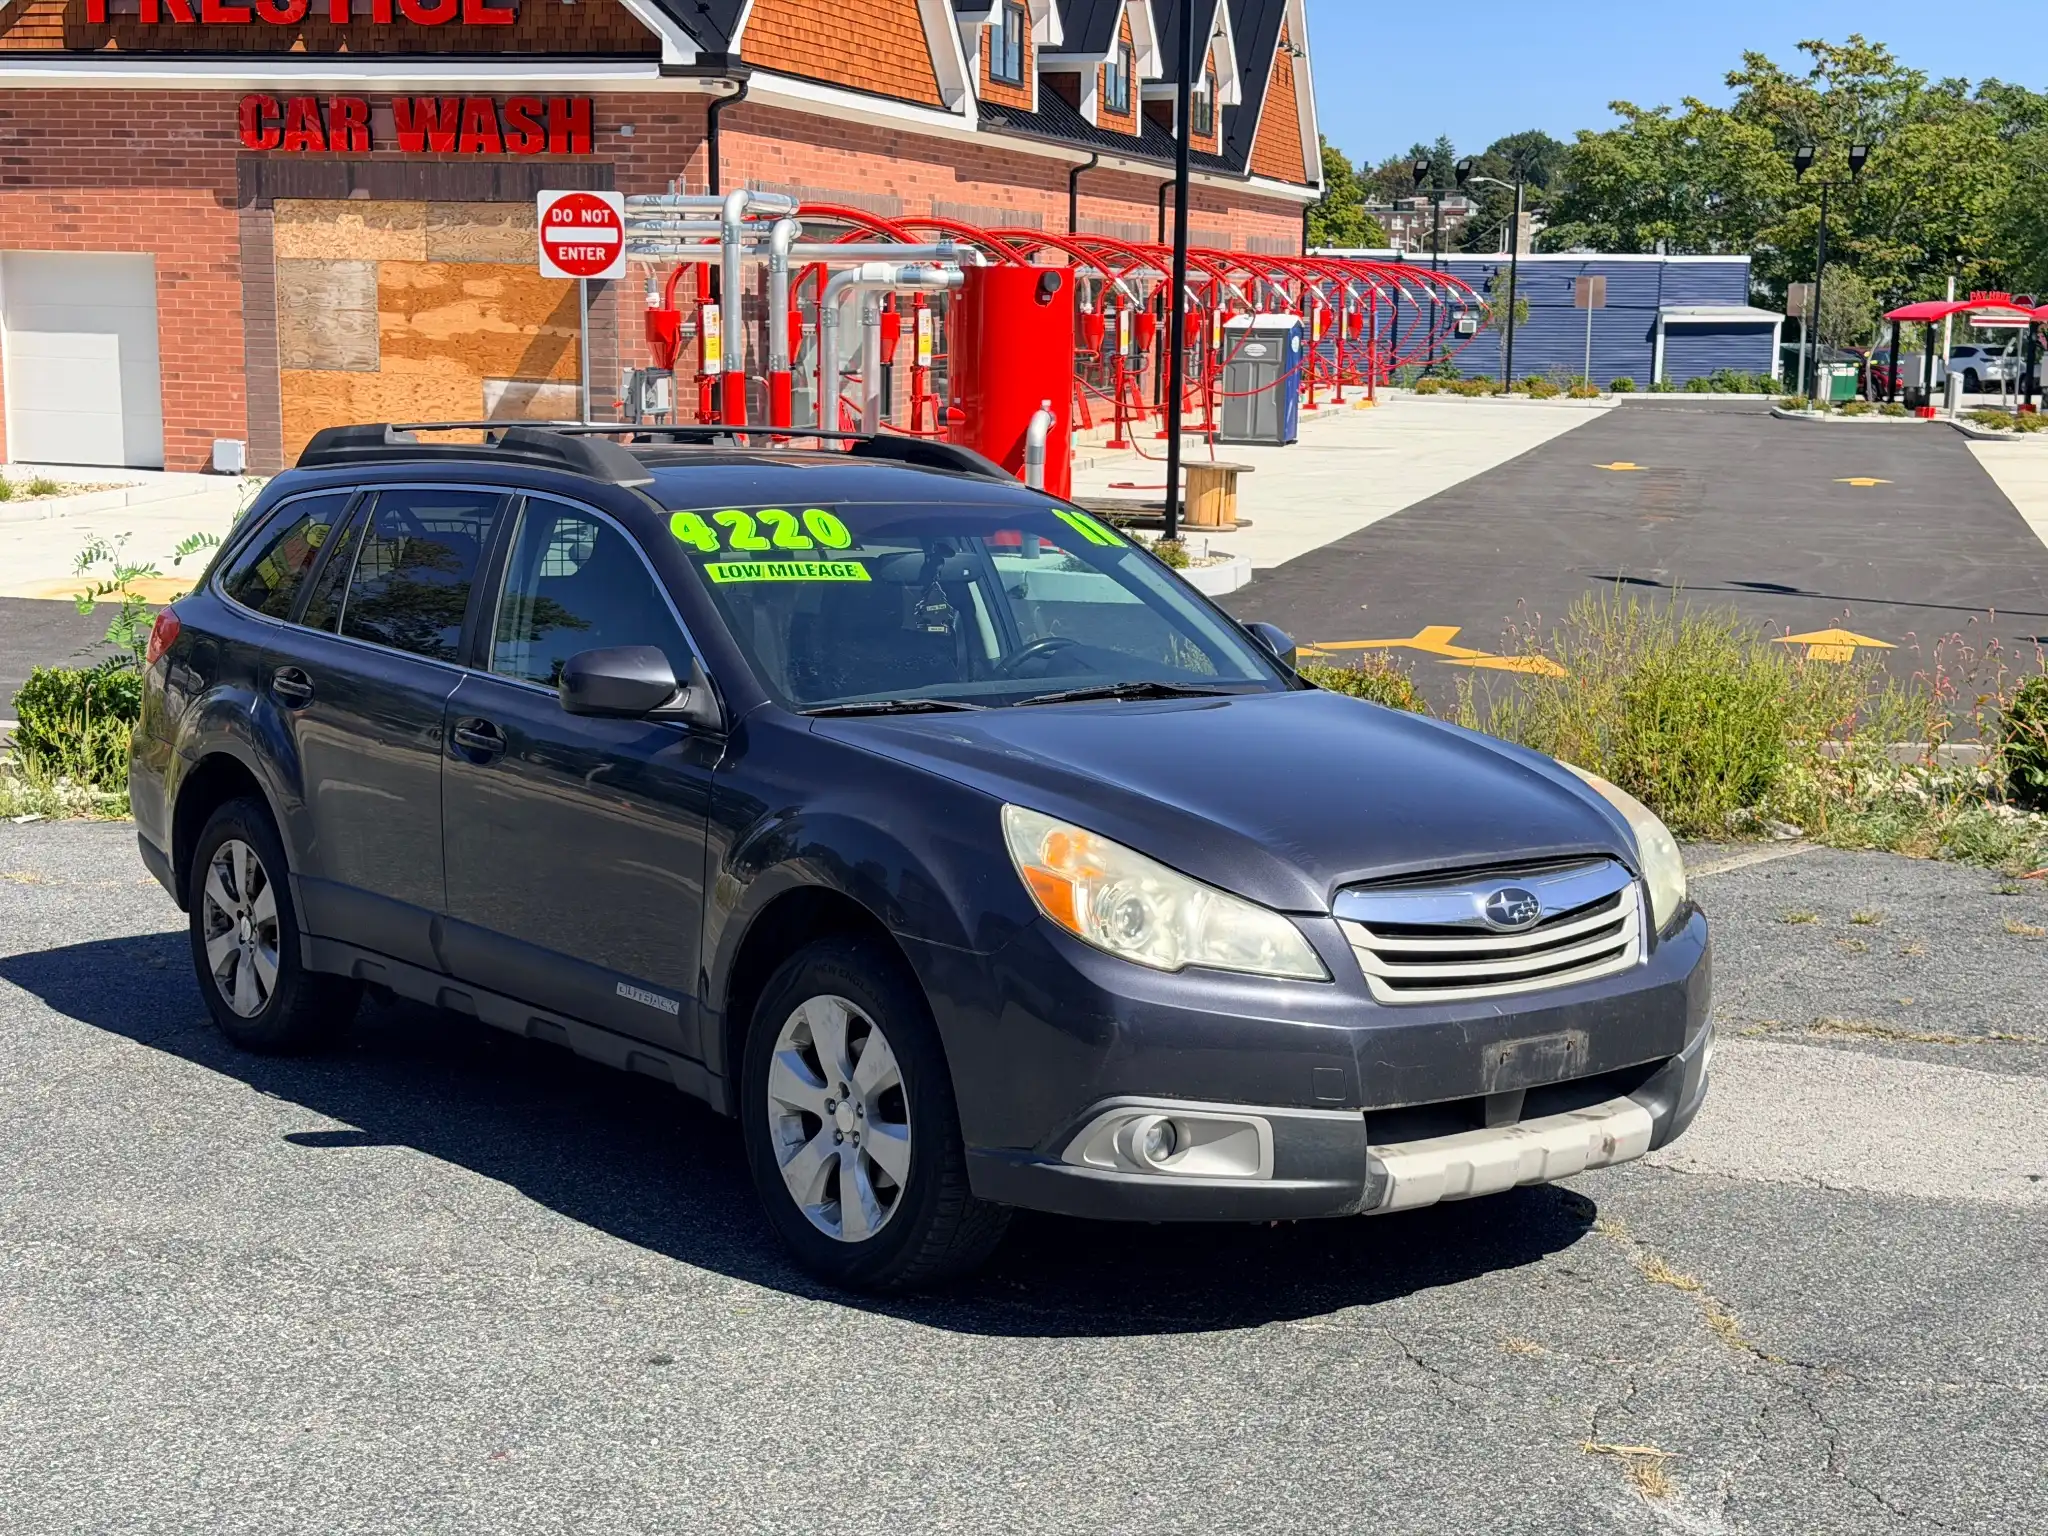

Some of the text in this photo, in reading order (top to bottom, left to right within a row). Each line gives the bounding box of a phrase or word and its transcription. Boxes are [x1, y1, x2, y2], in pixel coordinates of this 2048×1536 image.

[239, 94, 594, 154] CAR WASH
[552, 208, 611, 223] DO NOT
[558, 246, 606, 260] ENTER
[670, 508, 852, 552] 4220
[1051, 508, 1129, 548] 11
[717, 563, 857, 579] LOW MILEAGE
[618, 983, 679, 1014] OUTBACK
